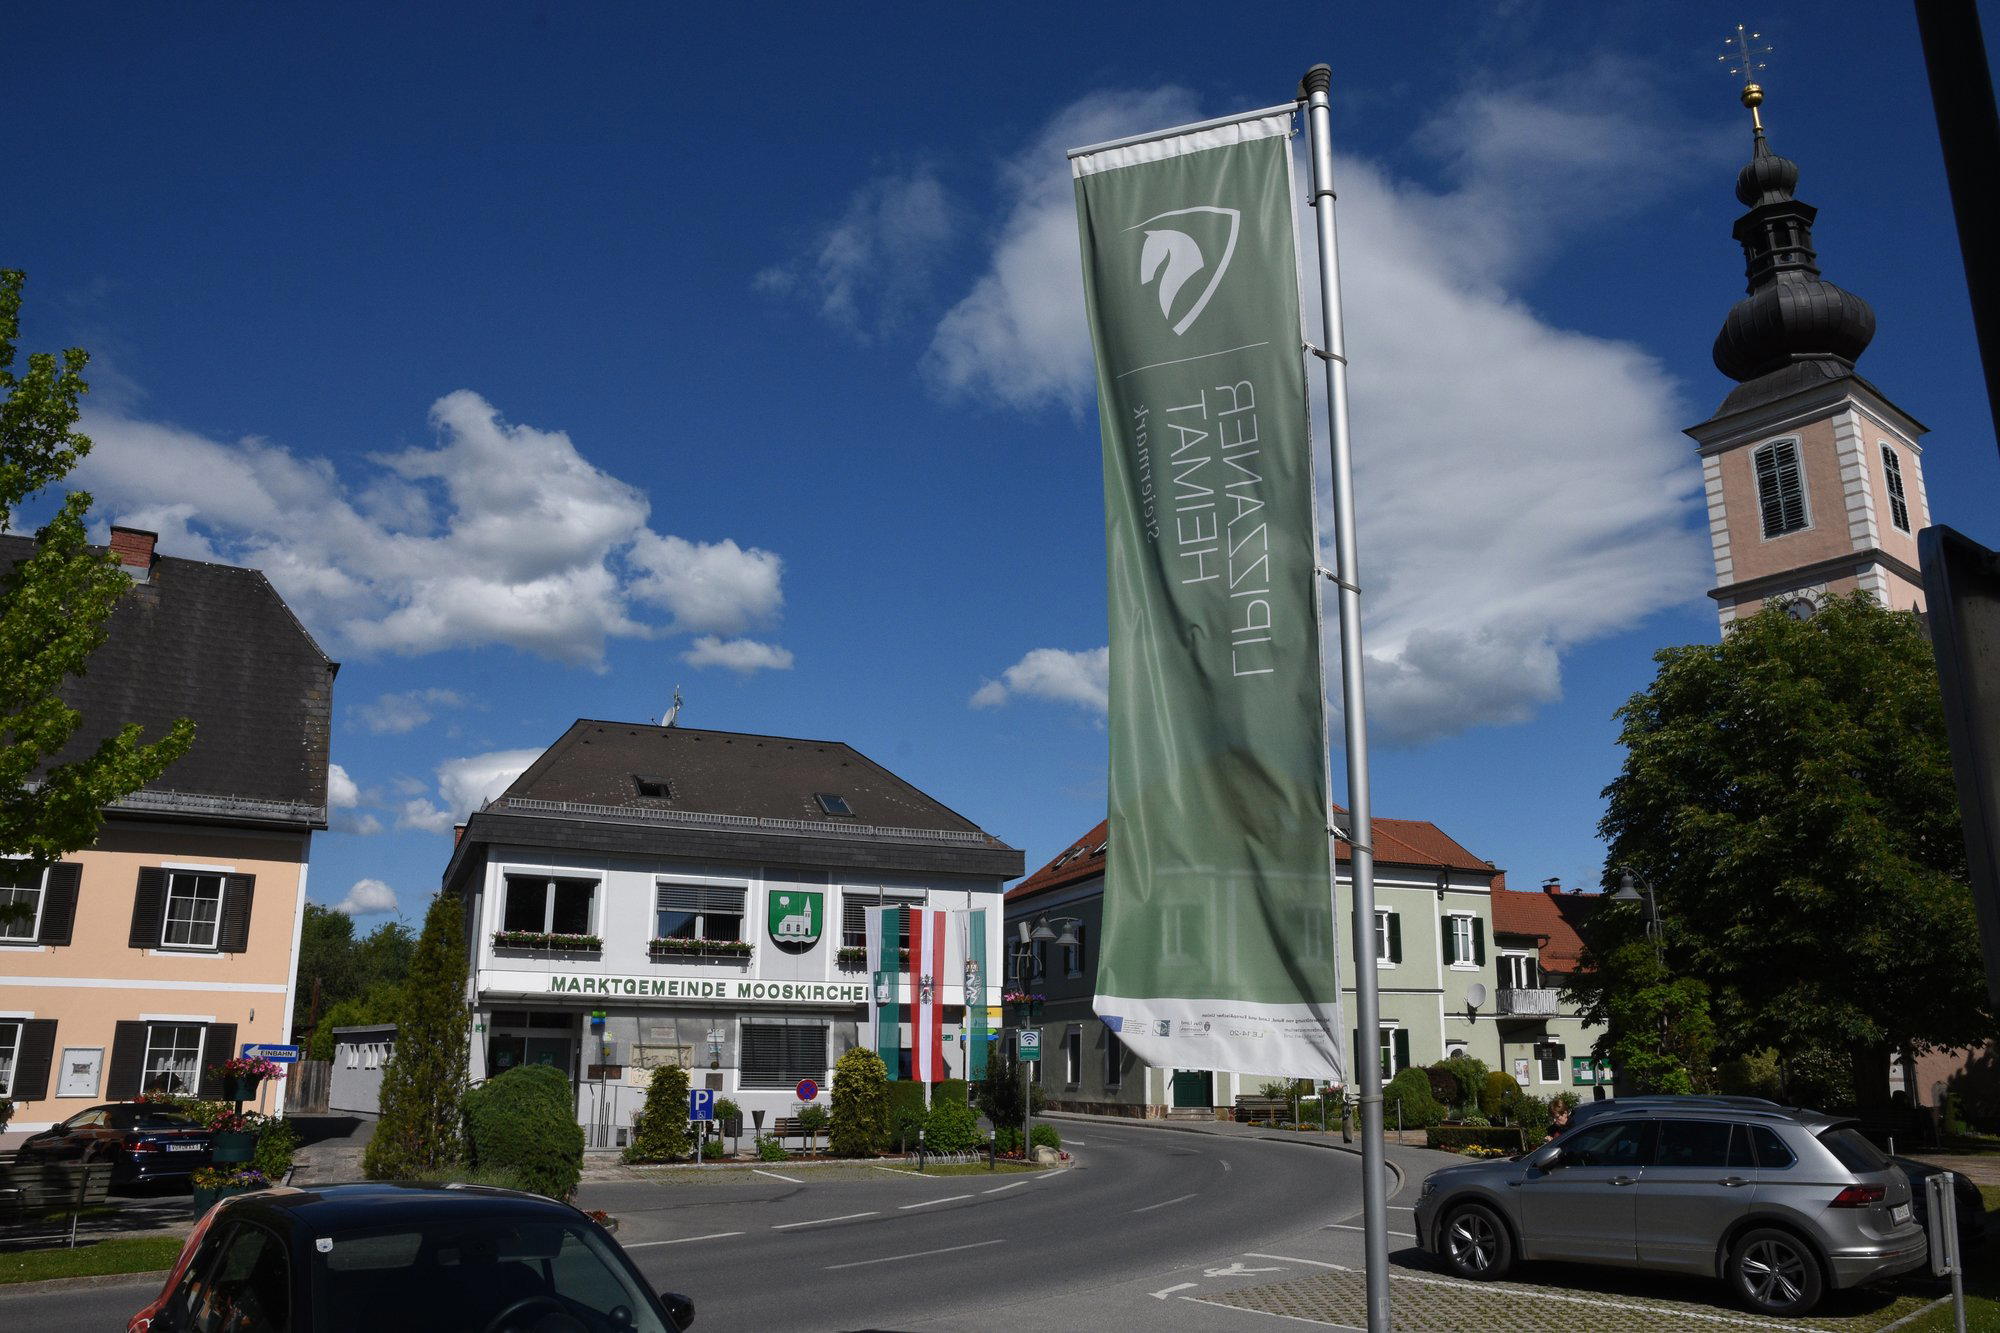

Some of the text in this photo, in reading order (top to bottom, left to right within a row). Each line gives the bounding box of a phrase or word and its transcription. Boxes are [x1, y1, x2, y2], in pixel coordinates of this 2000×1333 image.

[551, 976, 869, 1001] MARKTGEMEINDE MOOSKIRCHE
[695, 1090, 709, 1111] P
